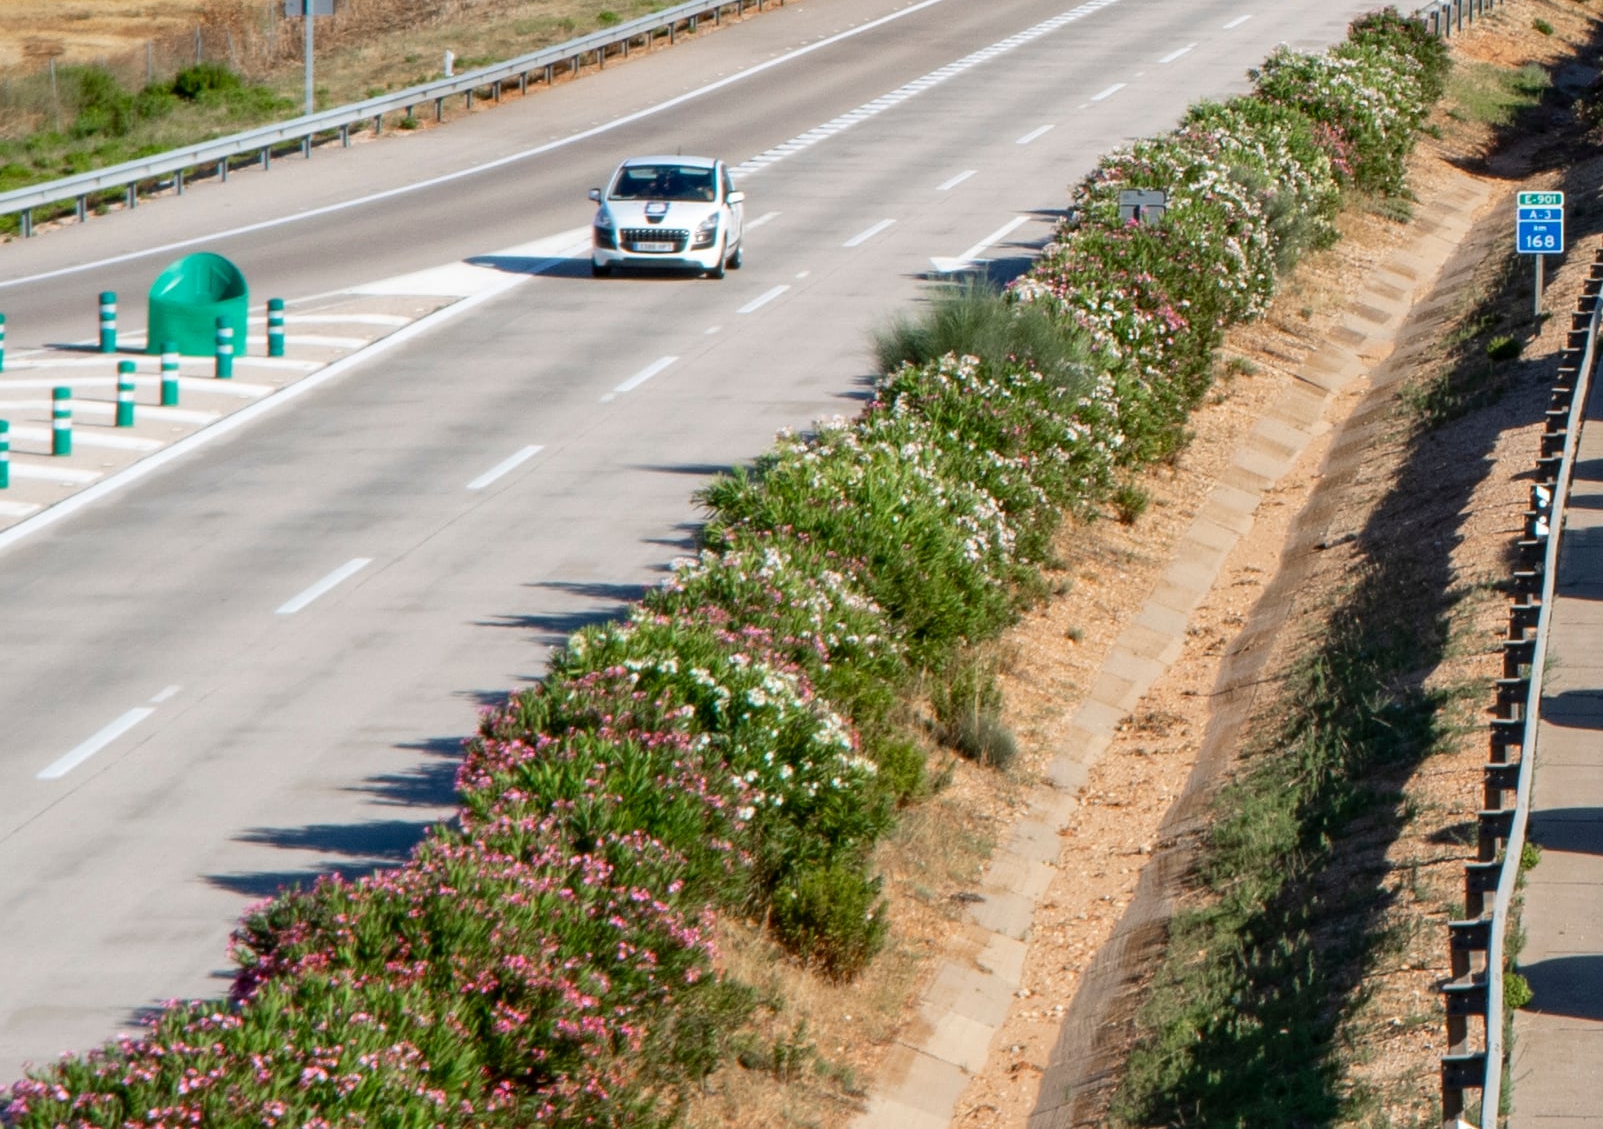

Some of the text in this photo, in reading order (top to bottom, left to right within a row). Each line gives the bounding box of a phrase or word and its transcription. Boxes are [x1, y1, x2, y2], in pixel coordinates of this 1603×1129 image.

[1525, 195, 1557, 204] E-901
[1529, 210, 1552, 219] A-3
[1526, 234, 1555, 248] 168
